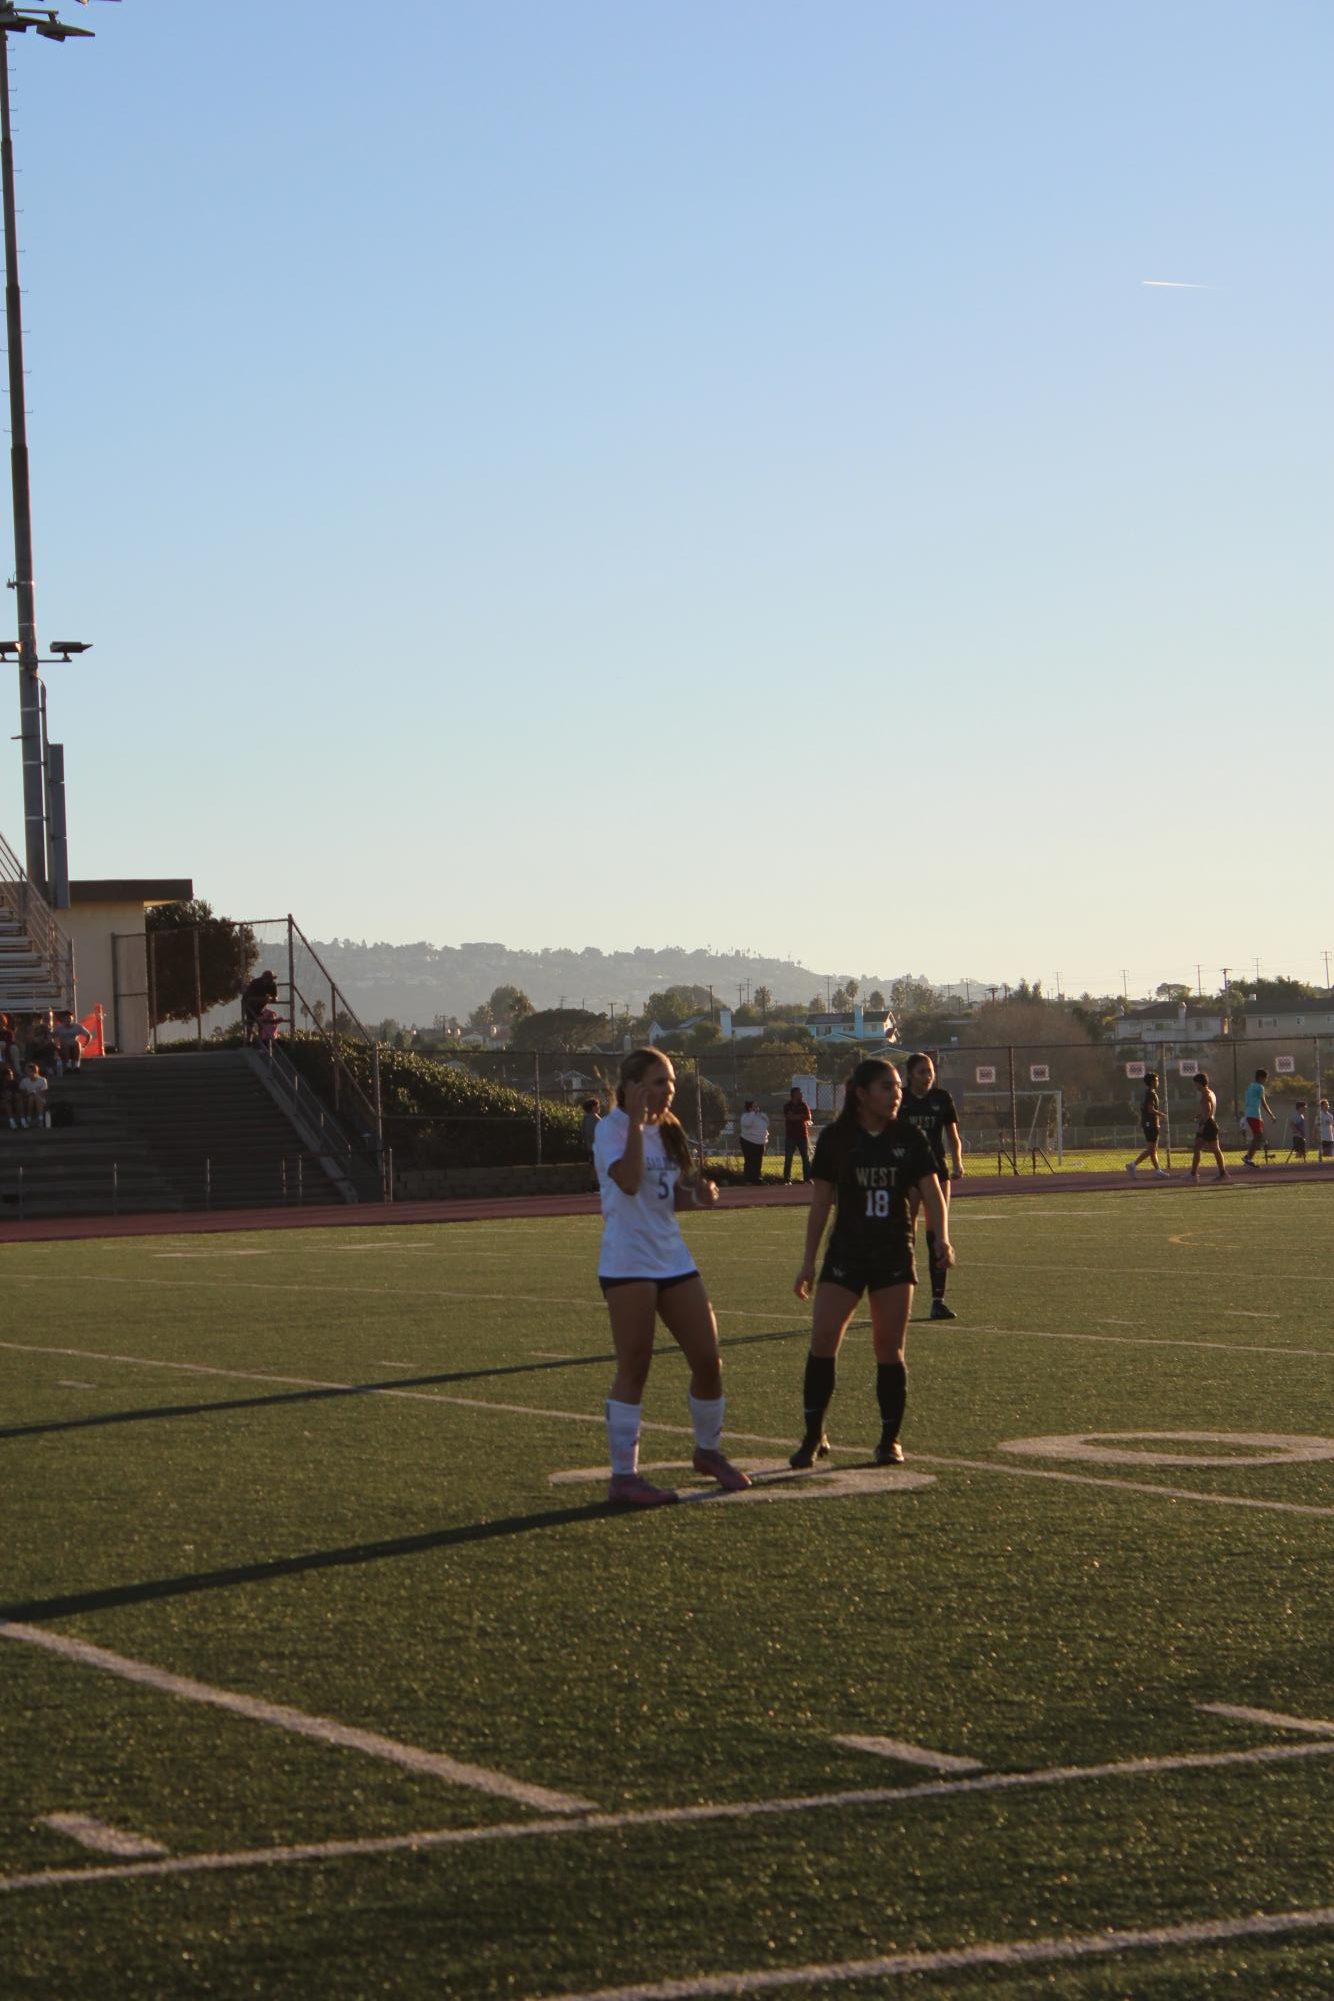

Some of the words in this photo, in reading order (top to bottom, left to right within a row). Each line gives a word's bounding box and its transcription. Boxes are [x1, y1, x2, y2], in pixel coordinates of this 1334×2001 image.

[656, 1172, 670, 1201] 5
[855, 1167, 897, 1187] WEST
[865, 1189, 890, 1217] 18
